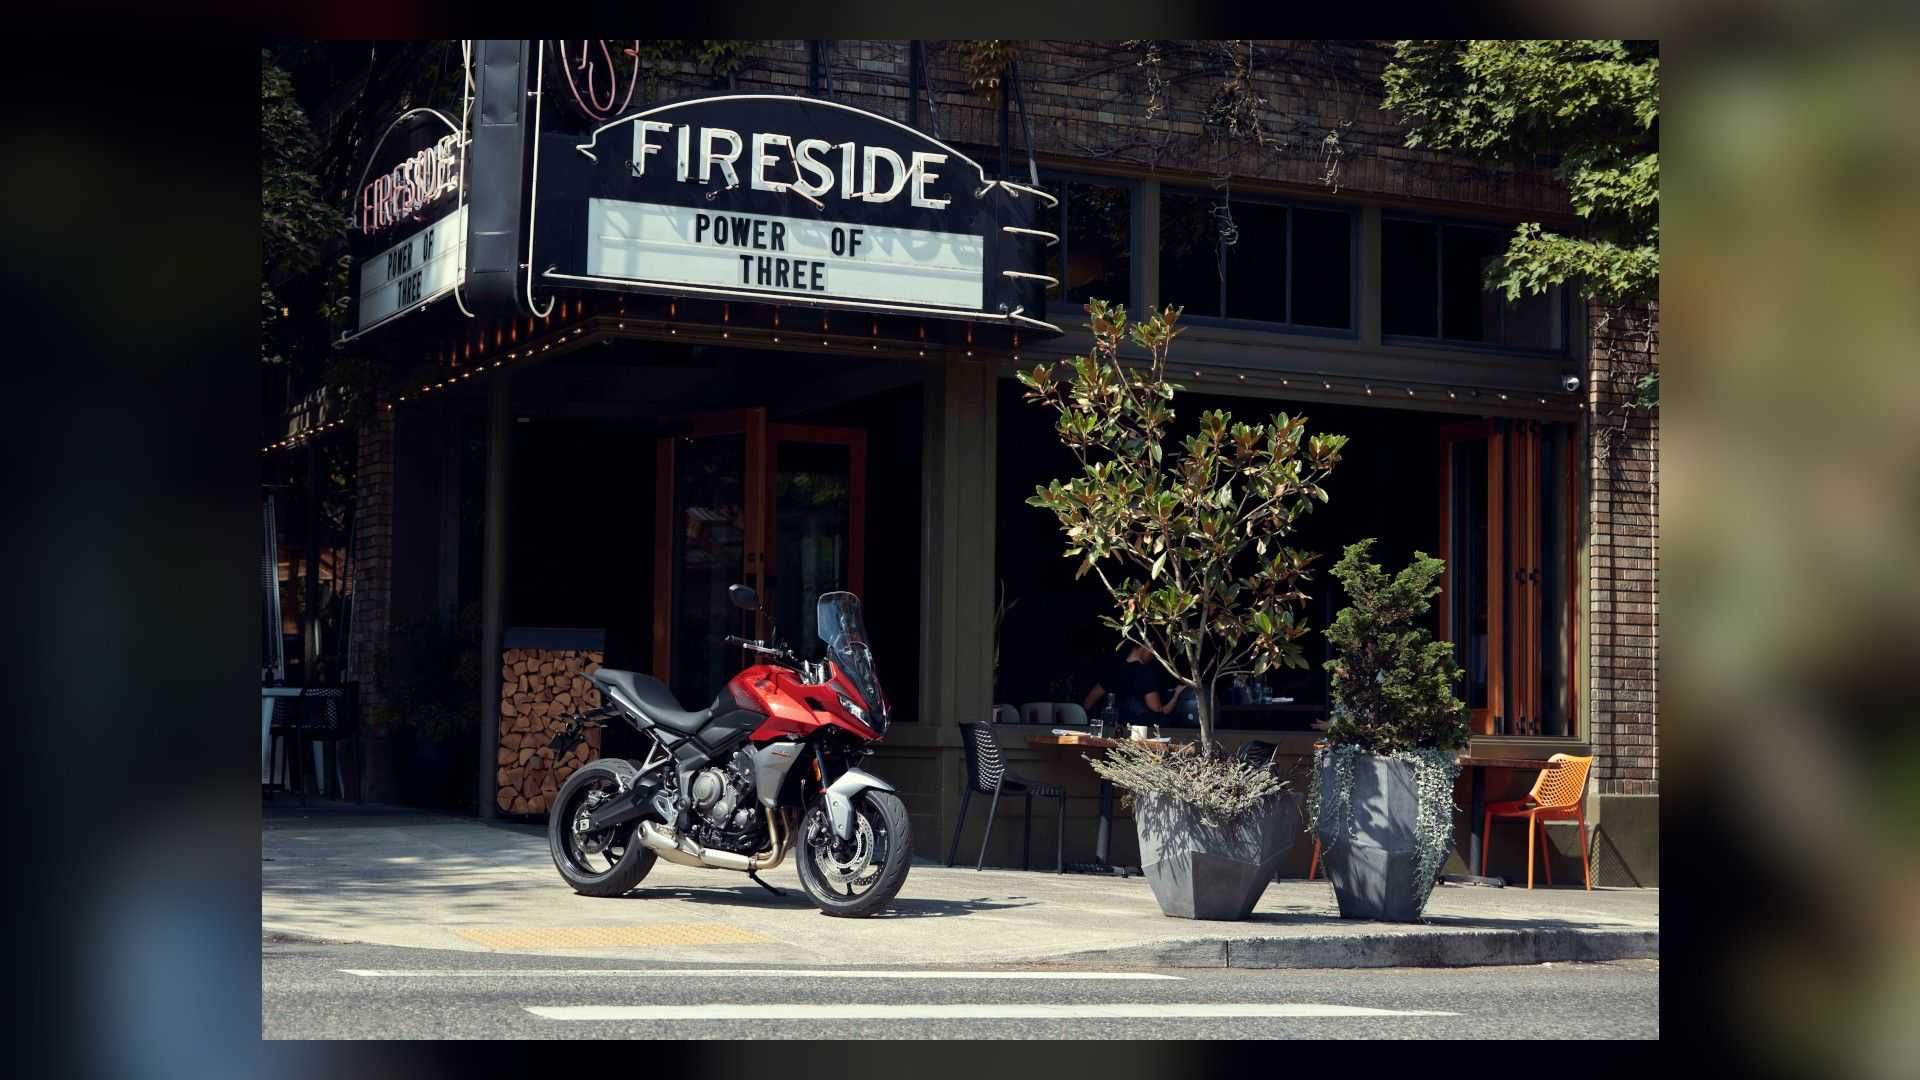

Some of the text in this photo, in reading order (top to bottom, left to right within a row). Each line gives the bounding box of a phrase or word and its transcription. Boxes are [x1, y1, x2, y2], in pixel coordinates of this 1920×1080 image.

[363, 134, 458, 235] FIRESIDE
[632, 120, 951, 210] FIRESIDE
[387, 229, 434, 280] POWER OF
[695, 213, 863, 257] POWER OF
[398, 270, 423, 308] THREE
[739, 254, 826, 291] THREE
